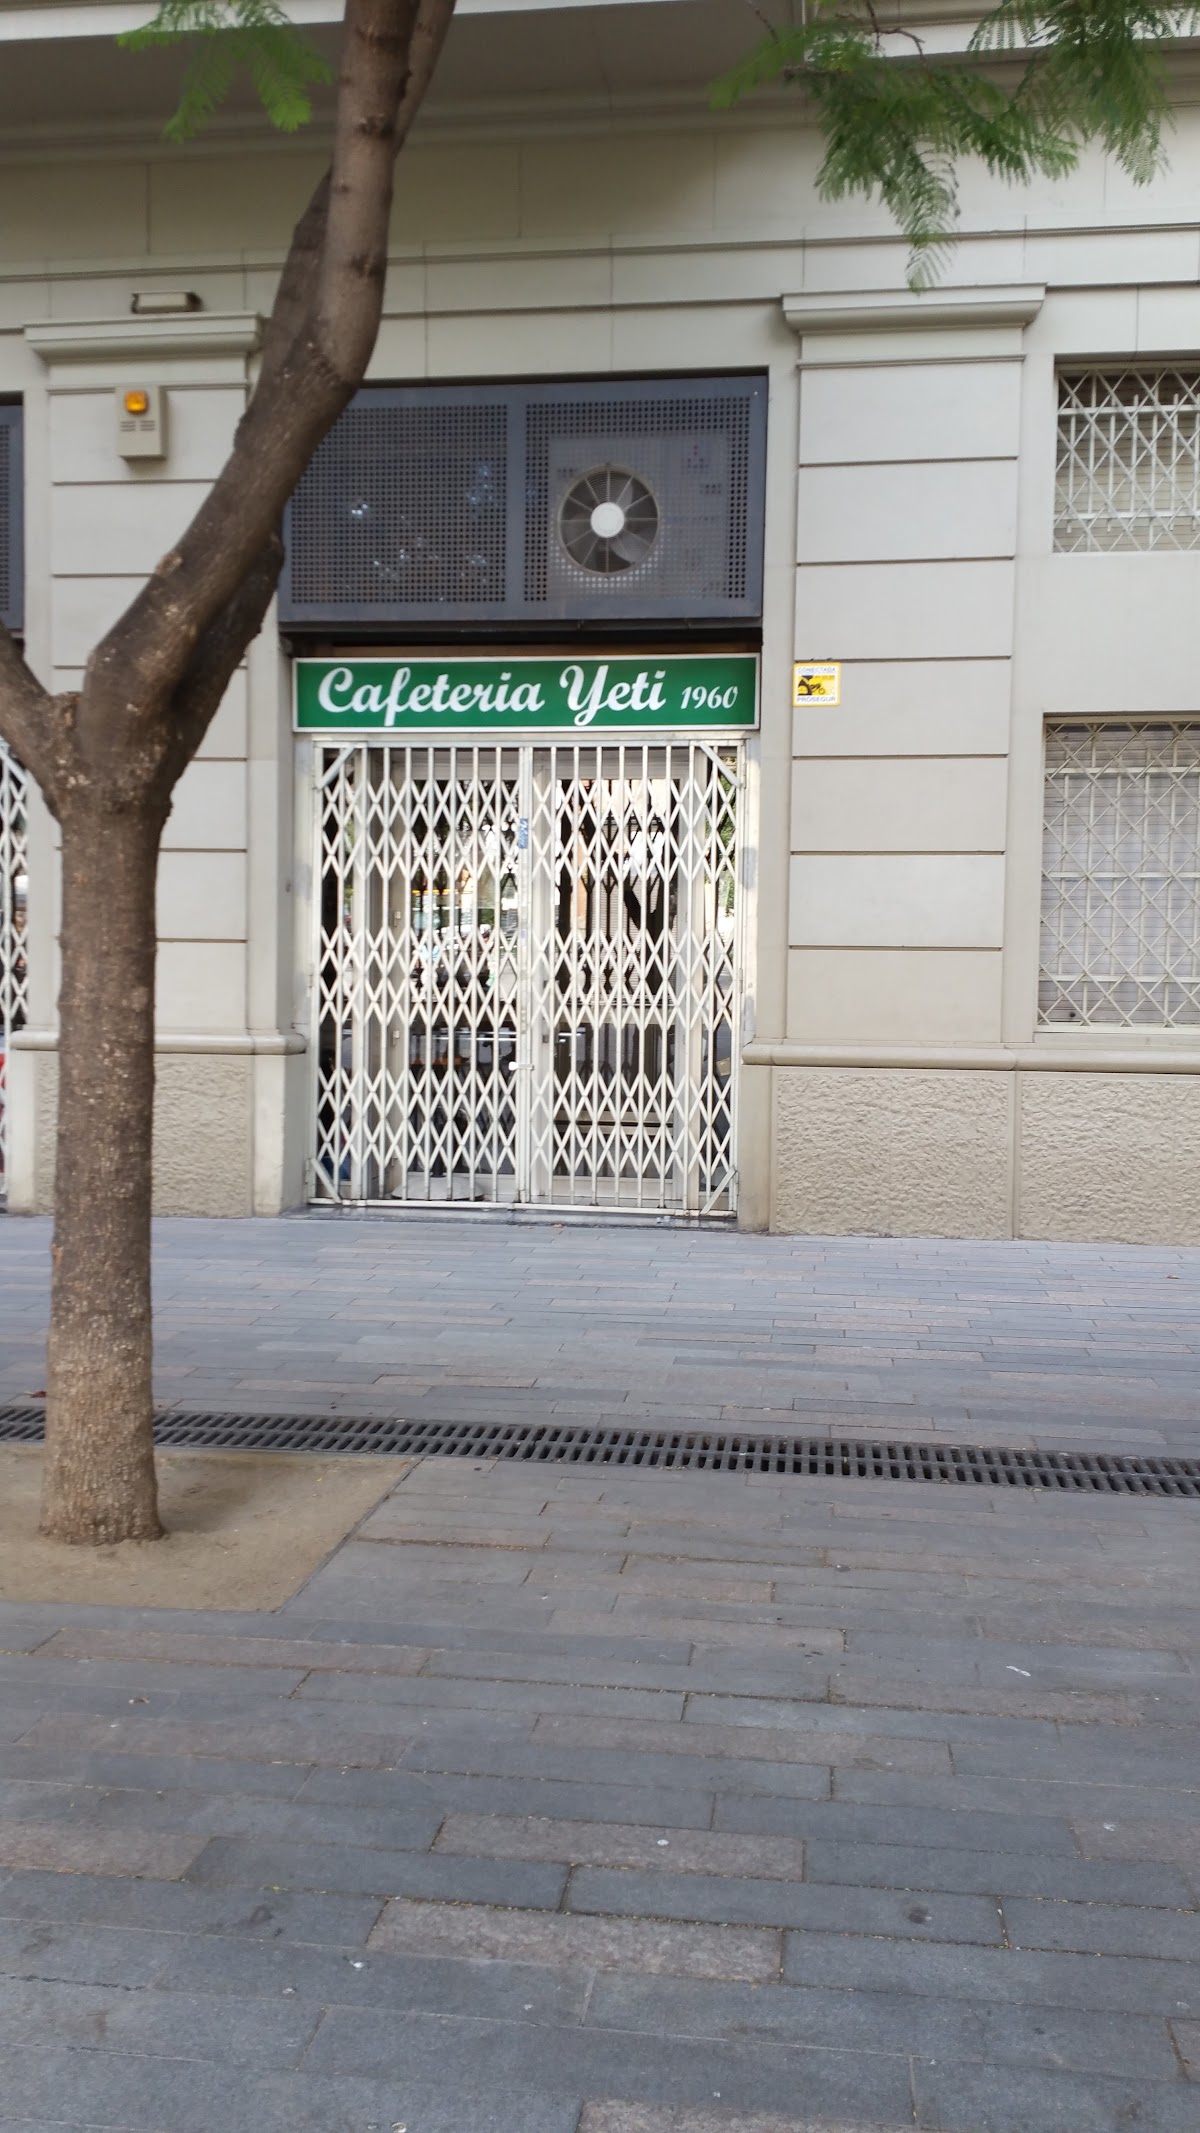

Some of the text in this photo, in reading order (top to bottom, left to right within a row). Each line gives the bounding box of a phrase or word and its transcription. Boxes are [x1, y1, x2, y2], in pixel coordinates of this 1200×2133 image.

[318, 665, 738, 726] Cafeteria Yeti 1960
